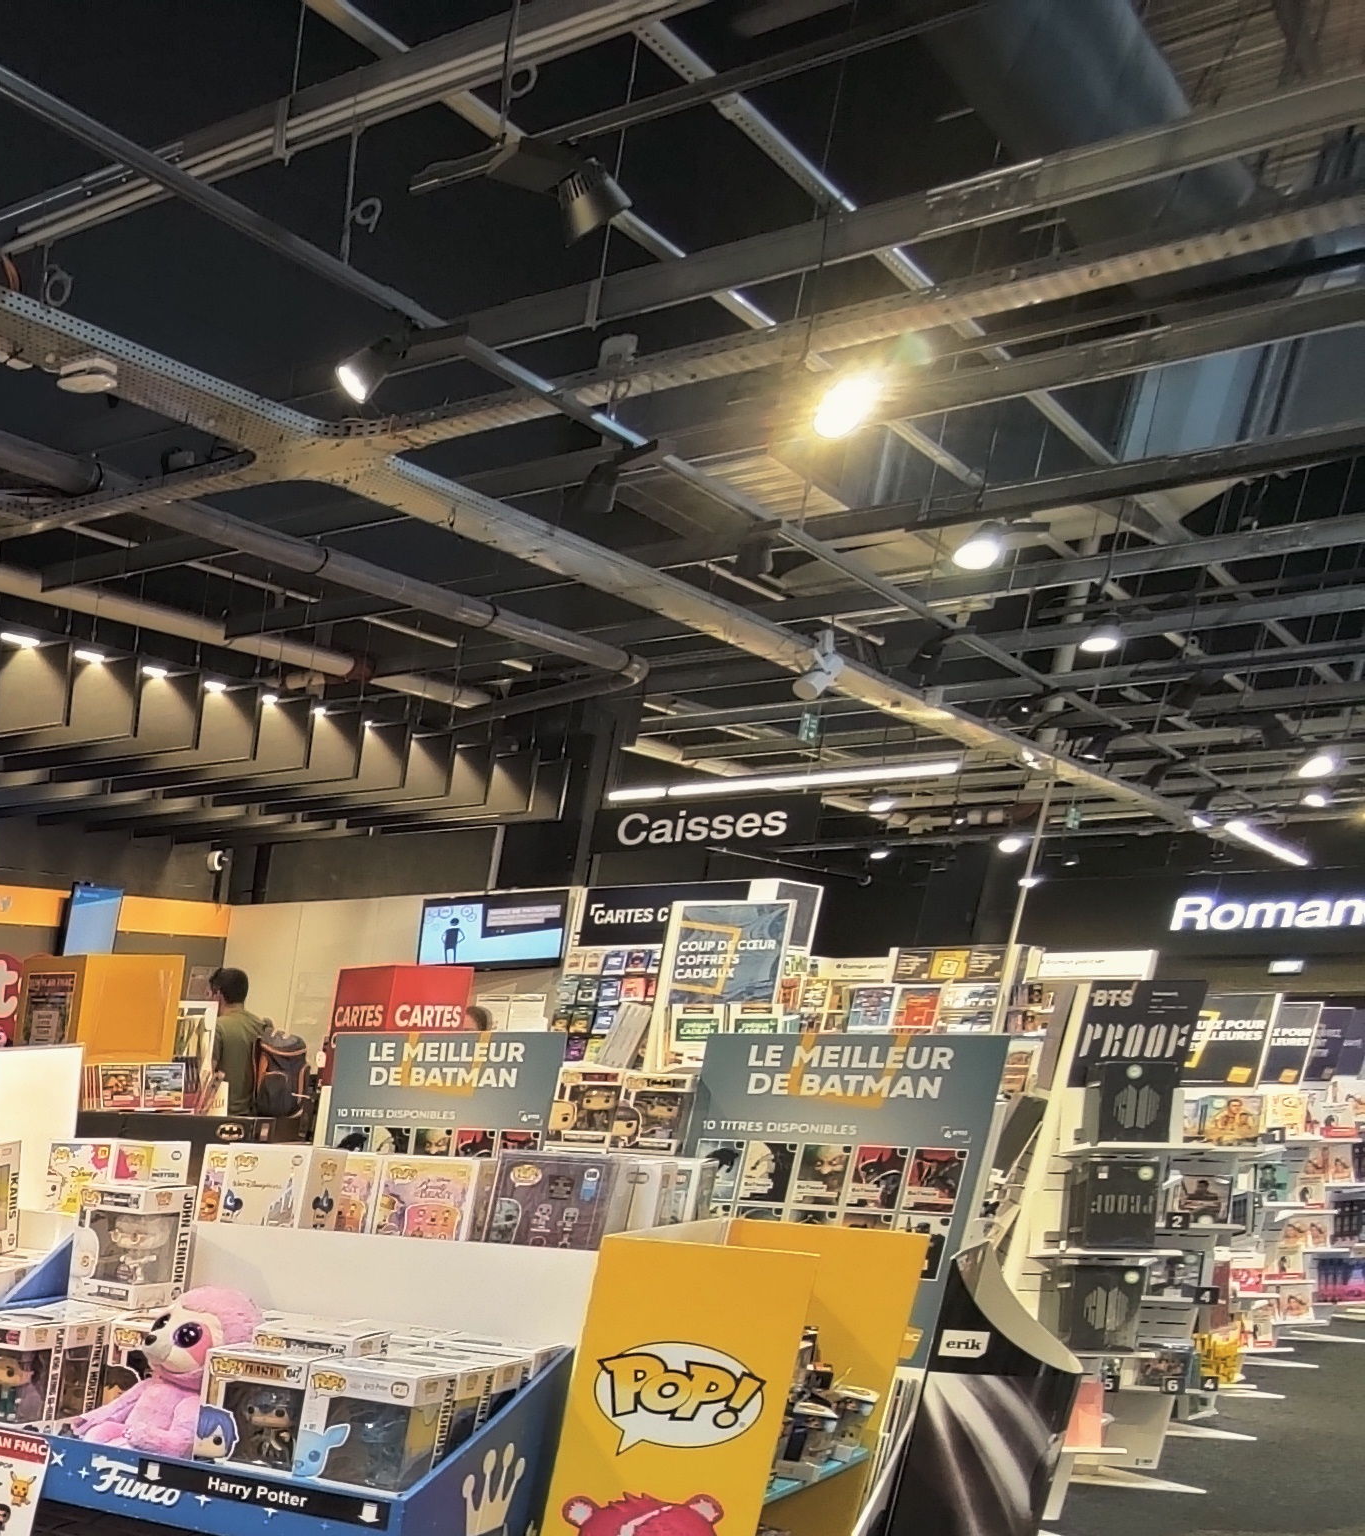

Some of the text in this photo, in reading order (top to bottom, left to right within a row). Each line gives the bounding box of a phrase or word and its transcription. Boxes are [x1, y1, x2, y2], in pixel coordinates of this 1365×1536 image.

[617, 808, 788, 847] Caisses
[593, 907, 654, 925] CARTES
[1170, 897, 1365, 930] Roman
[679, 940, 716, 952] COUP
[718, 940, 735, 951] DE
[676, 953, 740, 966] COFFRETS
[674, 968, 735, 979] CADEAUX
[1092, 989, 1133, 1007] BTS
[334, 1003, 463, 1028] CARTES CARTES
[1079, 1023, 1190, 1058] PROOF
[369, 1041, 525, 1063] LE MEILLEUR
[747, 1044, 955, 1071] LE MEILLEUR
[369, 1066, 518, 1089] DE BATMAN
[746, 1072, 943, 1100] DE BATMAN
[336, 1108, 456, 1121] 10 TITRES DISPONIBLES
[8, 1171, 18, 1219] IKARIS
[1171, 1214, 1183, 1228] 2
[174, 1192, 194, 1284] JOHN LENNON
[945, 1335, 983, 1354] erik
[597, 1351, 767, 1430] POP!
[13, 1439, 48, 1456] FNAC
[0, 1461, 14, 1470] POP
[208, 1476, 308, 1508] Harry Potter
